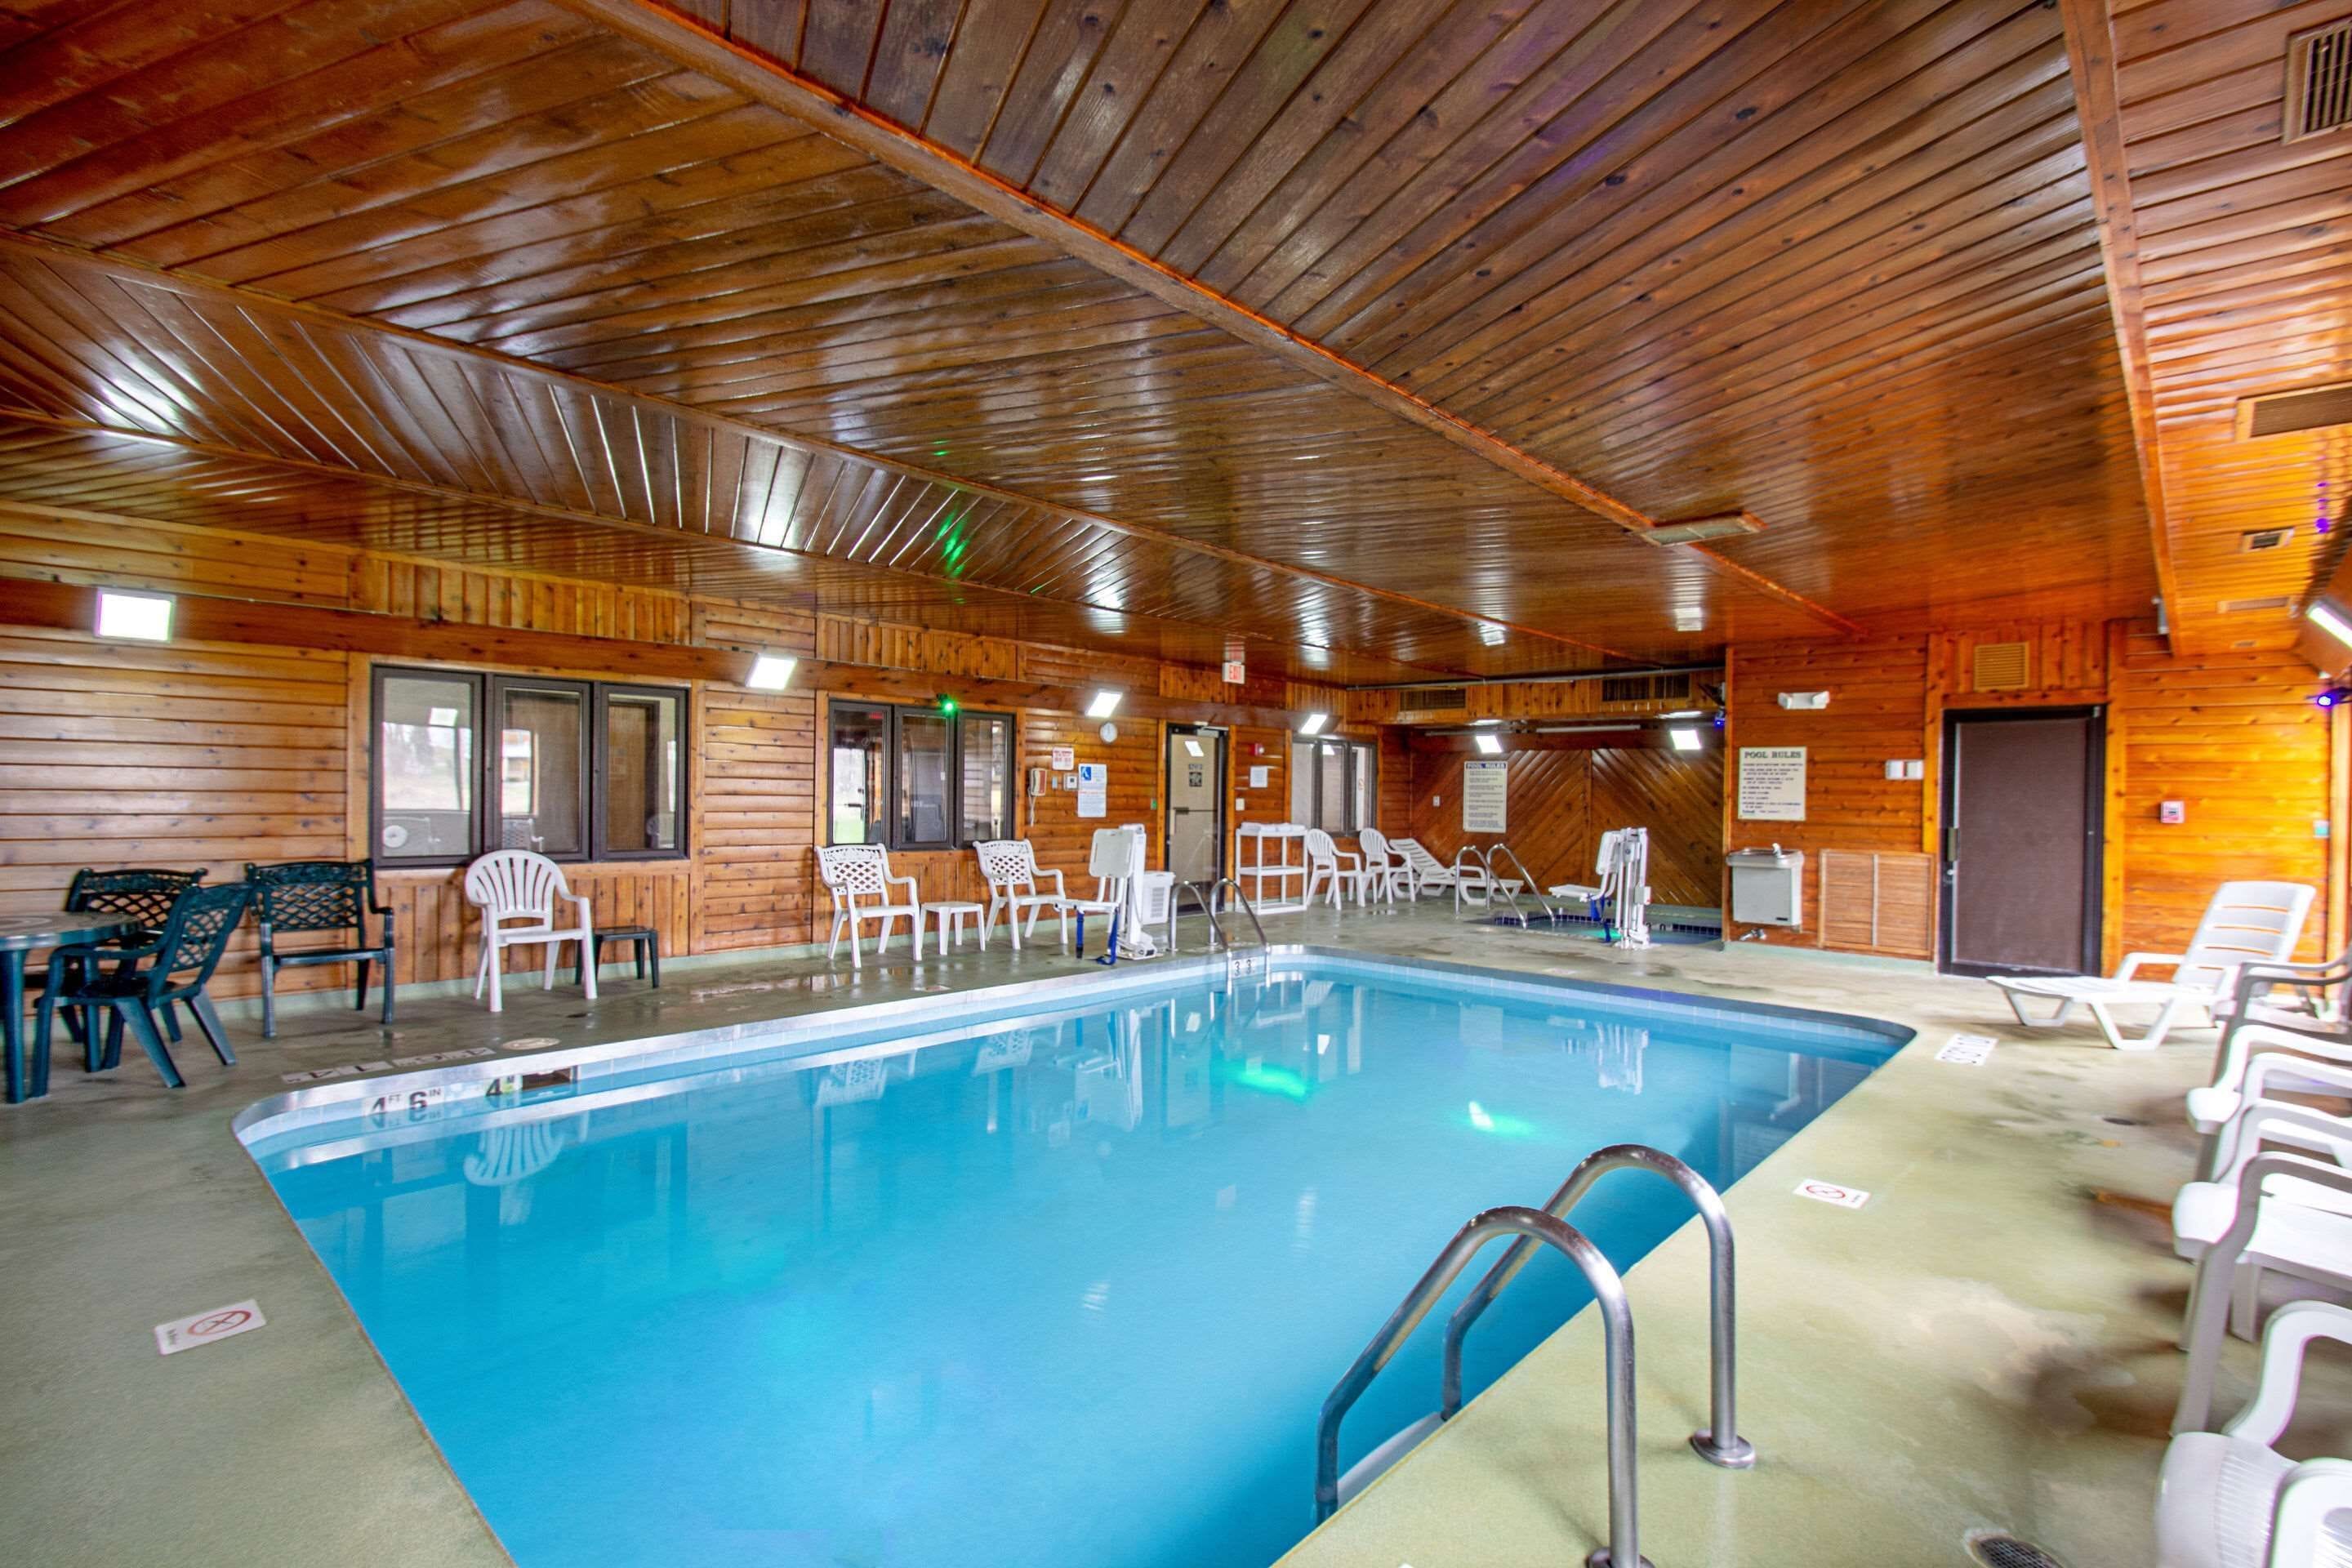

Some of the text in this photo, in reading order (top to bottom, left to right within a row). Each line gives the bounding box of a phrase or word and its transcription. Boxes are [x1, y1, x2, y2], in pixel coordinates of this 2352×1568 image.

[1744, 751, 1768, 759] POOL
[485, 1077, 503, 1097] 4
[388, 1094, 401, 1104] FT
[409, 1091, 427, 1109] 6
[429, 1088, 442, 1098] IN
